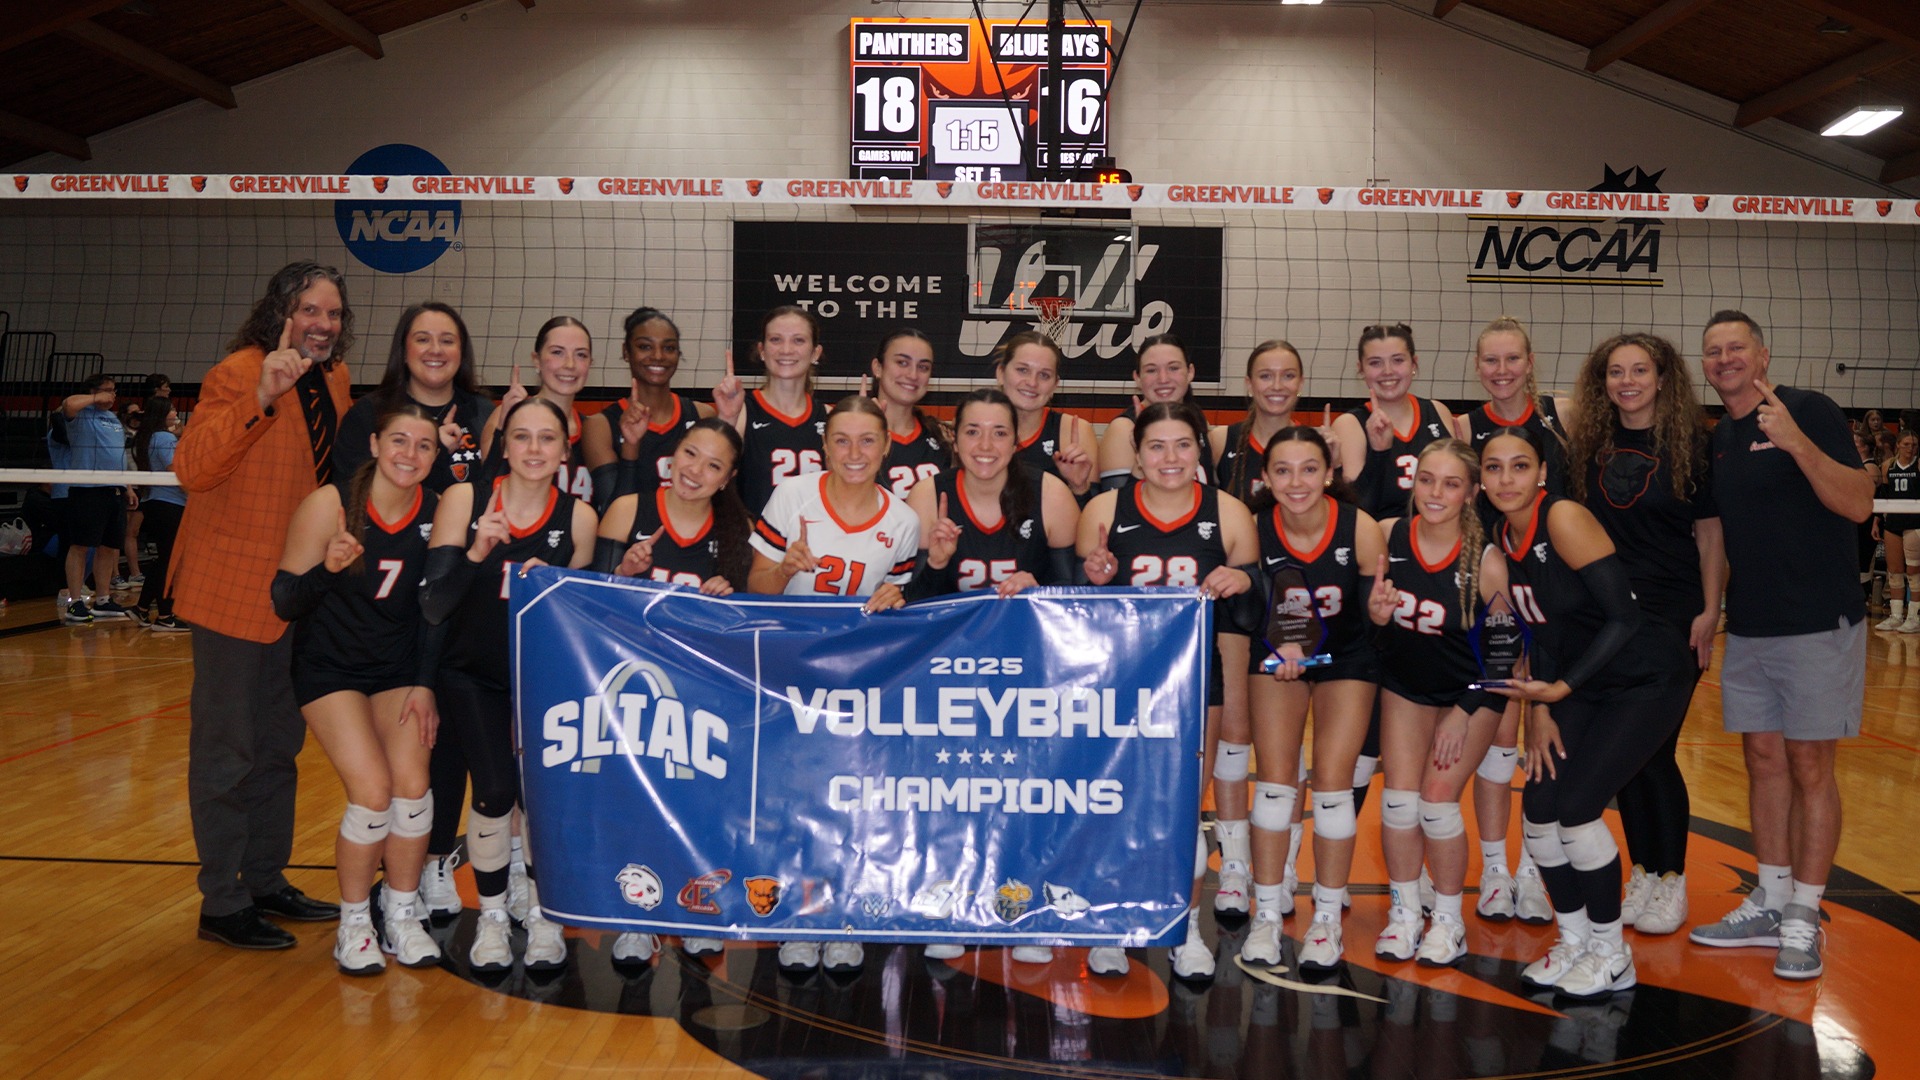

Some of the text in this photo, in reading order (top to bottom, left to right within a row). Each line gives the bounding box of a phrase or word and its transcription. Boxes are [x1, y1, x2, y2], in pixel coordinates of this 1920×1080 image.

[859, 32, 963, 57] PANTHERS
[999, 33, 1100, 58] BLUEAYS
[856, 76, 915, 133] 18
[946, 119, 1000, 151] 1:15
[858, 150, 914, 162] GAMES WON
[50, 175, 169, 193] GREENVILLE
[229, 176, 350, 194] GREENVILLE
[412, 176, 535, 194] GREENVILLE
[954, 167, 1002, 183] SET 5
[598, 178, 723, 197] GREENVILLE
[787, 180, 913, 198] GREENVILLE
[977, 182, 1103, 201] GREENVILLE
[1167, 185, 1294, 204] GREENVILLE
[1357, 188, 1483, 208] GREENVILLE
[1546, 192, 1670, 212] GREENVILLE
[1733, 196, 1854, 216] GREENVILLE
[348, 209, 459, 242] NCAA
[1474, 226, 1661, 273] NCCAA
[773, 274, 942, 294] WELCOME
[796, 300, 918, 319] TO THE
[1894, 478, 1908, 492] 10
[876, 531, 894, 549] GU
[374, 559, 404, 600] 7
[814, 554, 866, 595] 21
[957, 558, 1018, 592] 25
[1130, 554, 1199, 586] 28
[1284, 584, 1343, 618] 23
[1512, 584, 1548, 624] 11
[1393, 593, 1448, 636] 22
[929, 657, 1023, 675] 2025
[786, 686, 1176, 739] VOLLEYBALL
[542, 692, 729, 780] SLIAC
[828, 775, 1124, 815] CHAMPIONS
